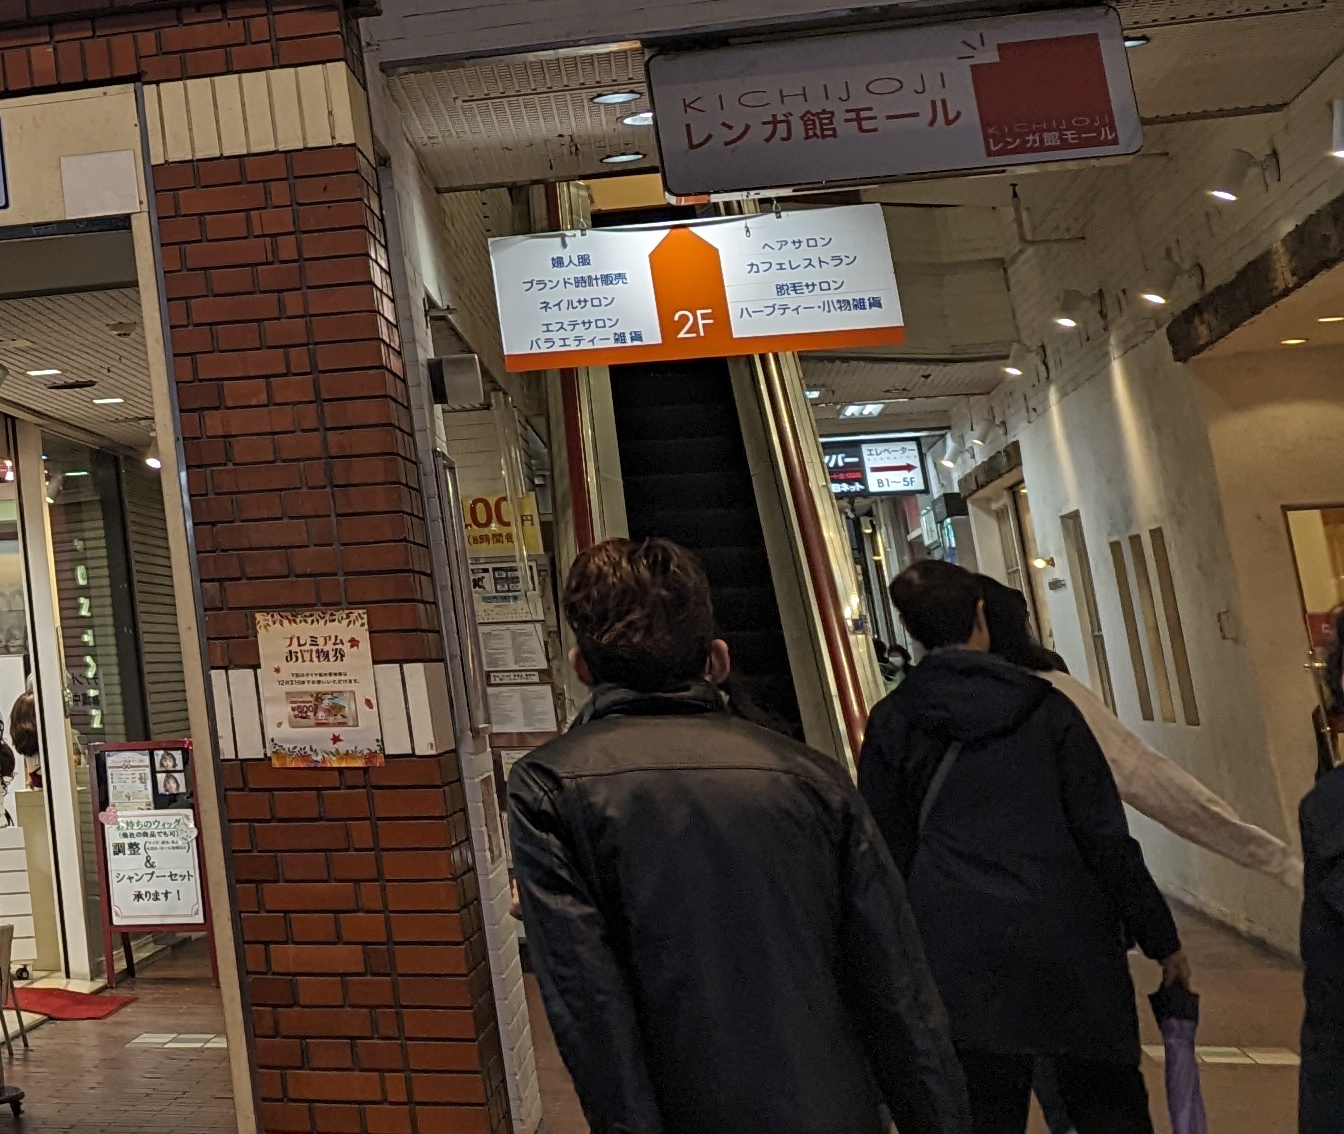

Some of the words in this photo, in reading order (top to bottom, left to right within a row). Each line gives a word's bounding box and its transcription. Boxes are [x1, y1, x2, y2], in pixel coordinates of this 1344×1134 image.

[681, 71, 948, 115] KICHIJOJI
[685, 97, 963, 151] レンガ館モール
[987, 115, 1112, 135] KICHIJOJI
[988, 126, 1116, 152] レンガ館モール
[761, 236, 833, 252] ヘアサロン
[550, 254, 591, 269] 婦人服
[746, 254, 858, 275] カフェレストラン
[522, 272, 628, 293] ブランド時計販売
[775, 280, 845, 297] 脱毛サロン
[538, 295, 616, 312] ネイルサロン
[541, 316, 621, 333] エステサロン
[673, 309, 714, 339] 2F
[529, 330, 644, 352] バラエティー雑貨
[866, 447, 916, 457] エレベーター
[283, 635, 344, 647] プレミアム
[285, 647, 346, 664] お買物券
[144, 855, 157, 869] &
[115, 870, 194, 884] シャンプーセット
